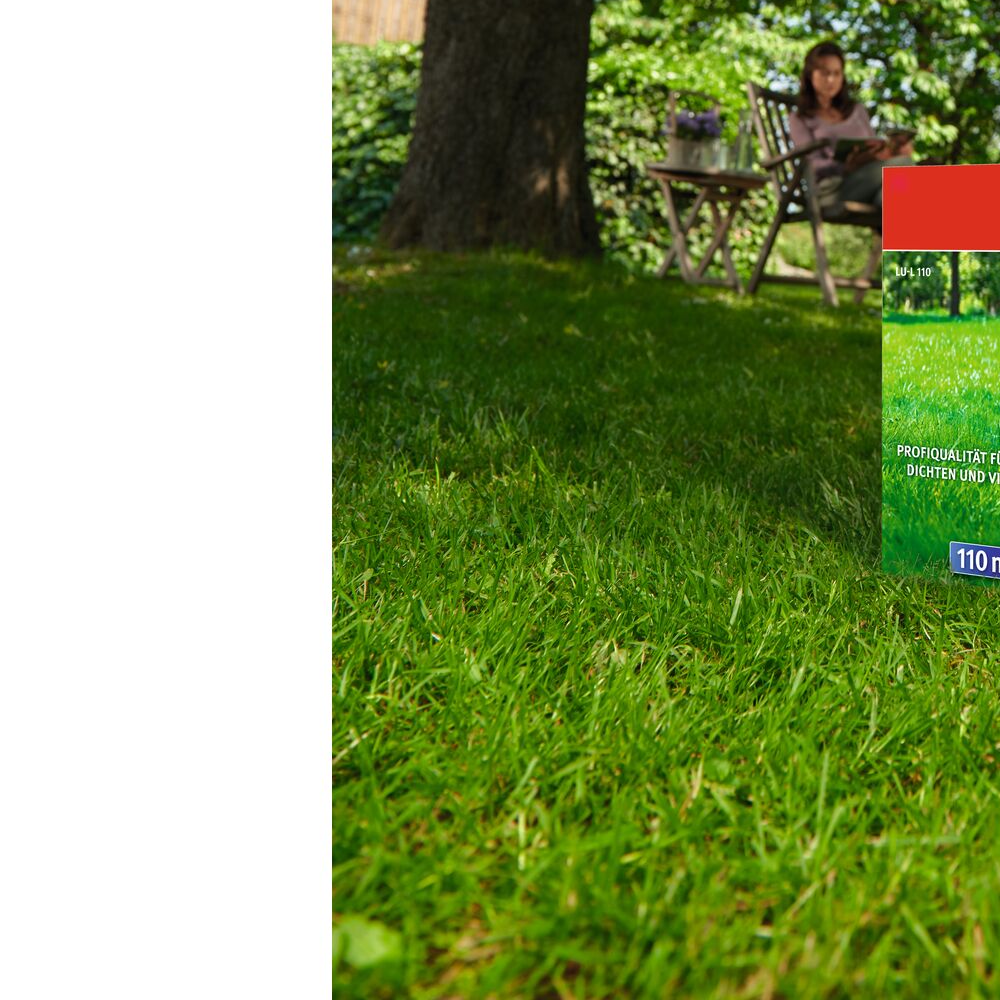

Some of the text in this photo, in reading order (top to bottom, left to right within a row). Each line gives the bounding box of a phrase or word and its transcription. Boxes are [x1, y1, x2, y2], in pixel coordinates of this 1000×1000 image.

[895, 266, 931, 277] LU-L 110
[897, 444, 987, 464] PROFIQUALITÄT
[907, 464, 956, 480] DICHTEN
[959, 469, 985, 483] UND
[957, 548, 988, 572] 110
